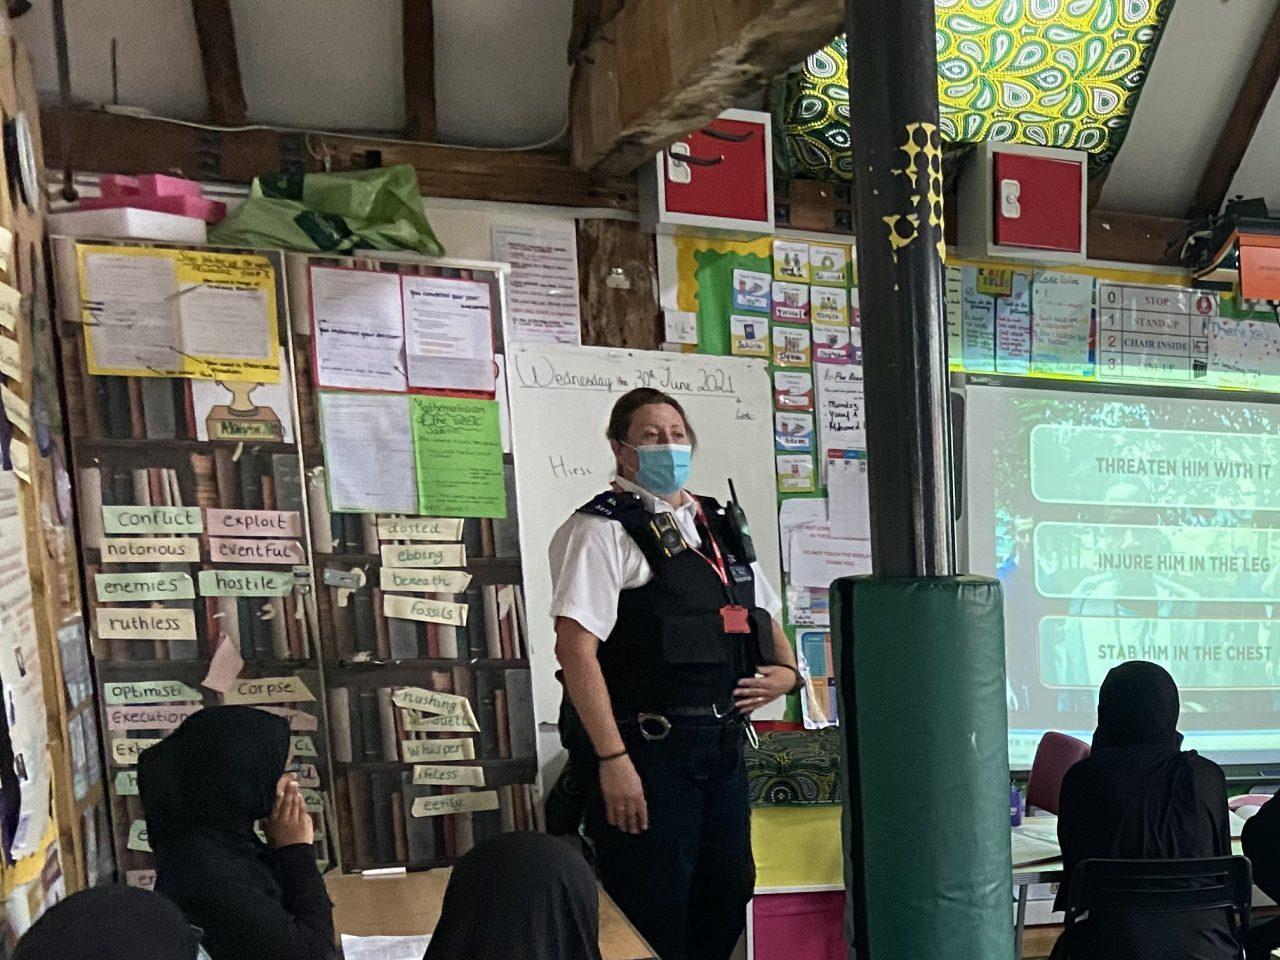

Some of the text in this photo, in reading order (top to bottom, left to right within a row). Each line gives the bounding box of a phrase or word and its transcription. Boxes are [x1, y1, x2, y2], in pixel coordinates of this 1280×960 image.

[1107, 291, 1170, 306] 0 STOP
[1108, 313, 1115, 326] 1
[1135, 317, 1166, 329] STAND
[1108, 335, 1188, 352] 2 CHAIR INSIDE
[515, 352, 613, 393] Wednesday
[660, 366, 693, 392] June
[697, 369, 736, 394] 2021
[549, 454, 592, 478] Hirsi
[1095, 456, 1272, 481] THREATEN HIM WITH IT
[222, 514, 288, 530] exploit
[387, 521, 443, 536] dusted
[107, 542, 186, 557] notorious
[1097, 553, 1271, 574] INJURE HIM IN THE LEG
[104, 578, 179, 595] enemies
[215, 572, 278, 591] hostile
[392, 572, 451, 588] beneath
[109, 616, 181, 632] ruthless
[1097, 644, 1273, 662] STAB HIM IN THE CHEST
